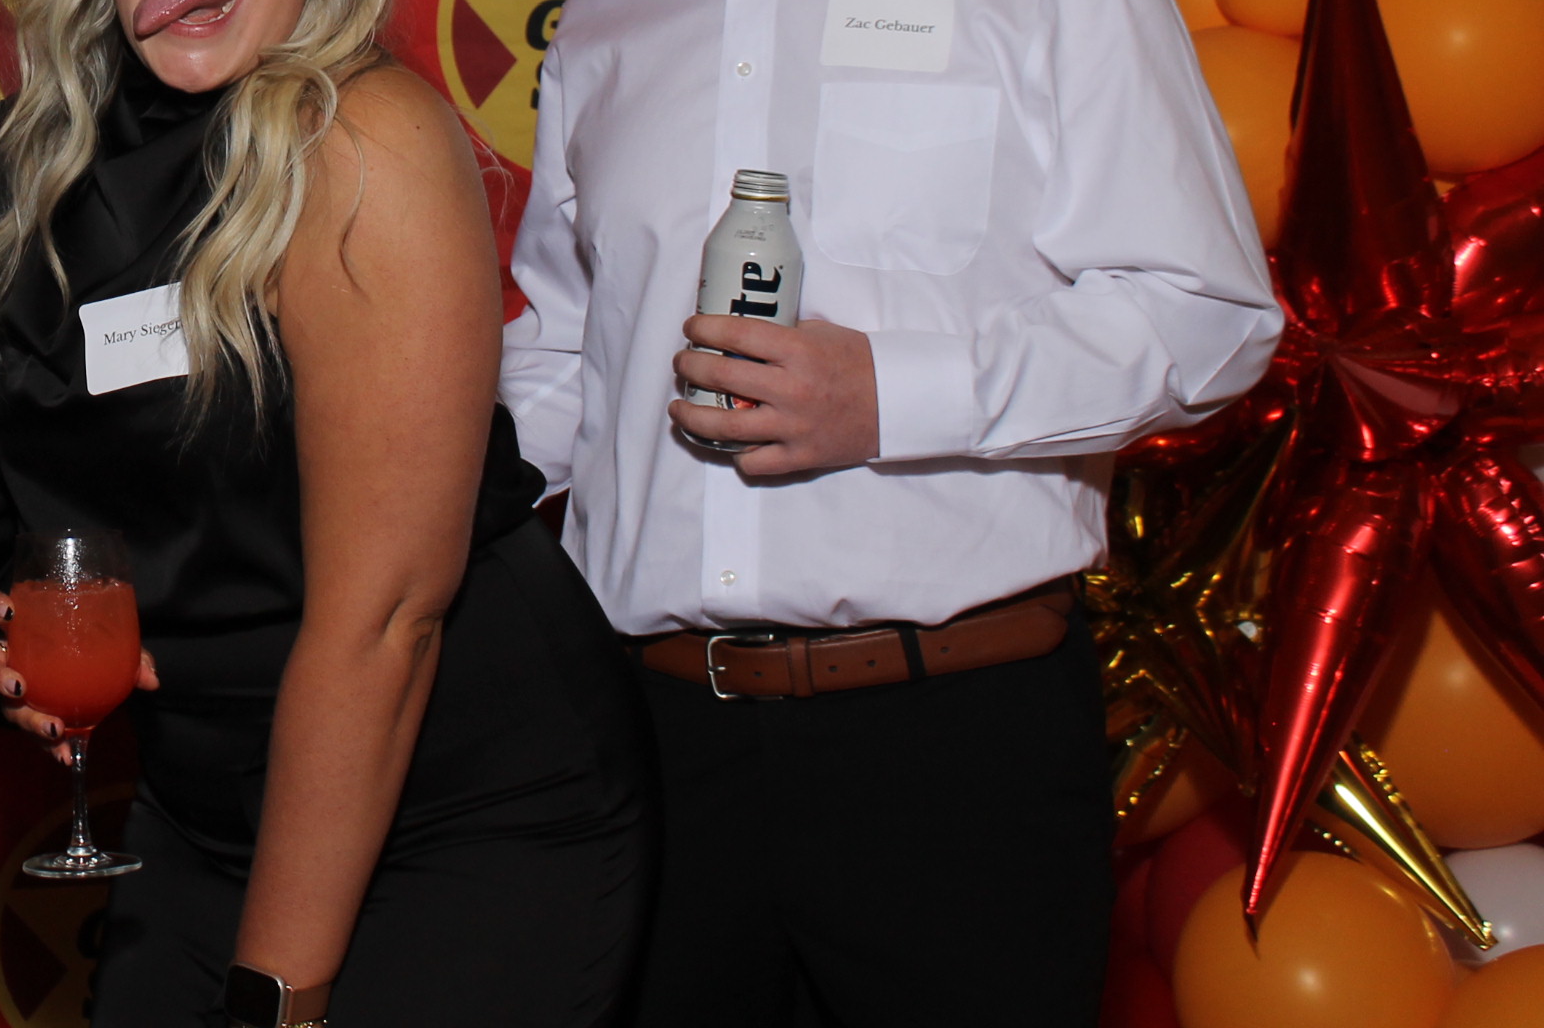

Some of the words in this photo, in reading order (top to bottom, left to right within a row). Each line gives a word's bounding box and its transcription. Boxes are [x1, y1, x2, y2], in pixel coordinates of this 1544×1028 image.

[844, 17, 871, 29] Zac
[874, 19, 936, 34] Gebauer
[730, 261, 781, 318] te
[103, 329, 137, 346] Mary
